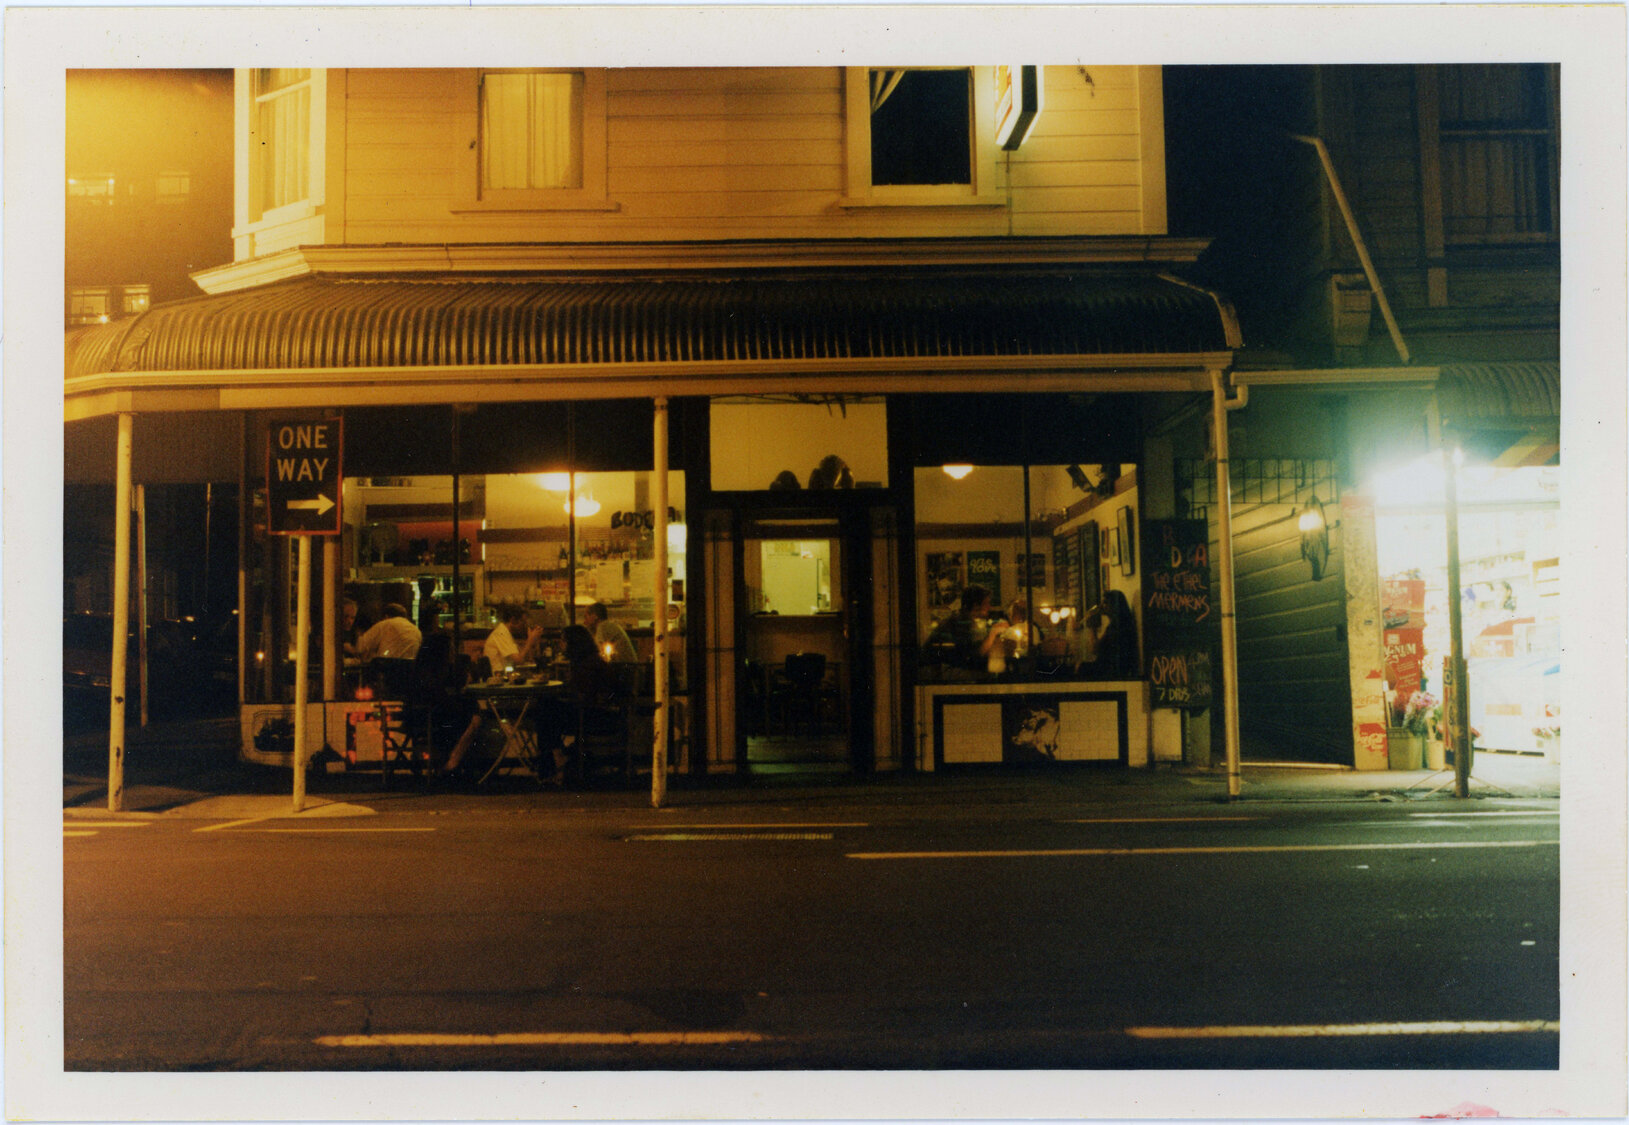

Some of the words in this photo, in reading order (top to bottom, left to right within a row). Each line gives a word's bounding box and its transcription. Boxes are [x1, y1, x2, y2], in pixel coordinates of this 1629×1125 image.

[278, 425, 328, 449] ONE
[277, 458, 329, 481] WAY
[1156, 687, 1166, 701] 7
